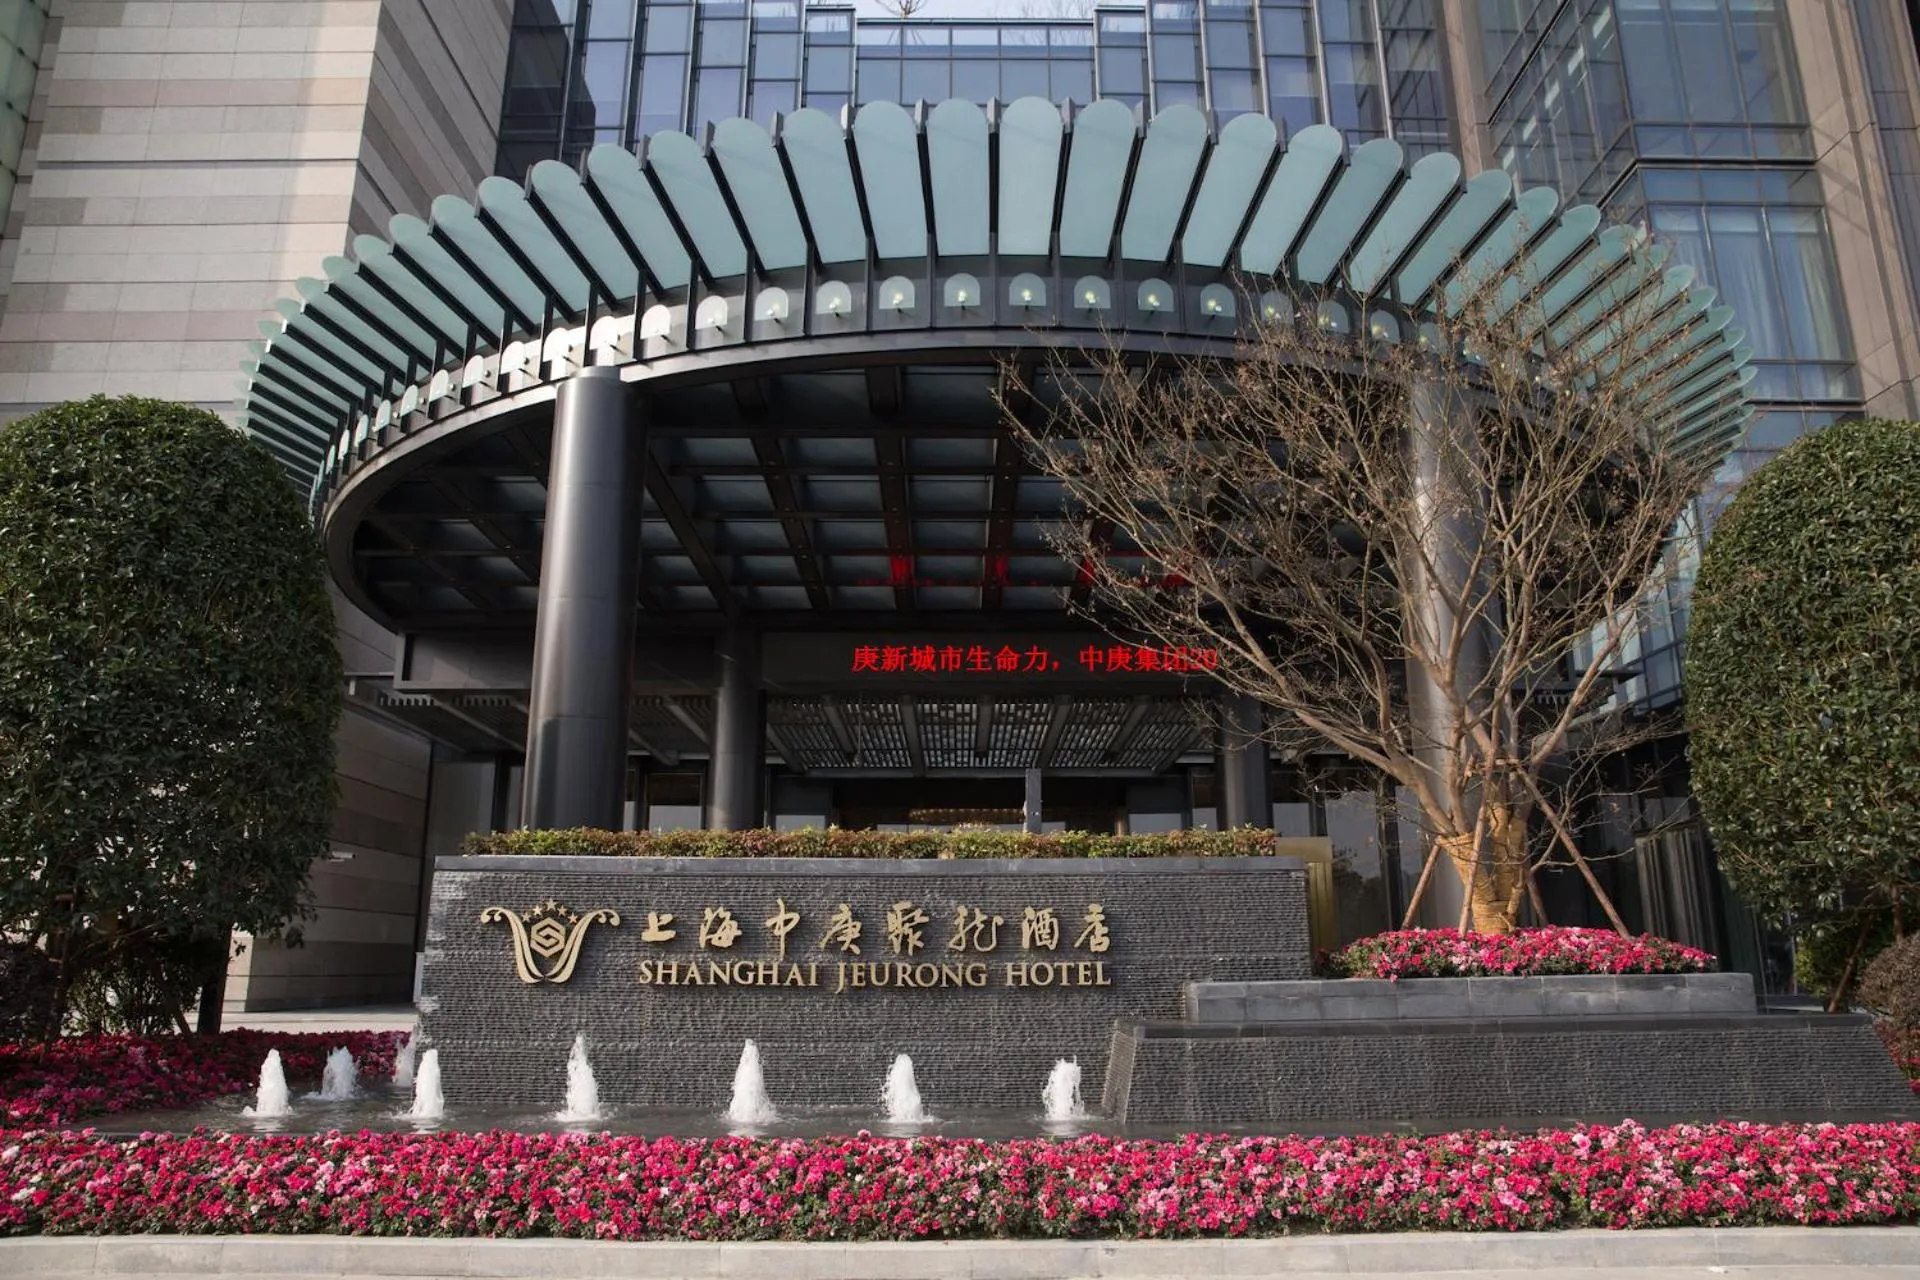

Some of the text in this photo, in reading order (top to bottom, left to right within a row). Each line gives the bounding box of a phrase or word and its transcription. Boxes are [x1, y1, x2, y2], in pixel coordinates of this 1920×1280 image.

[639, 960, 1112, 994] SHANGHAI JEURONG HOTEL
